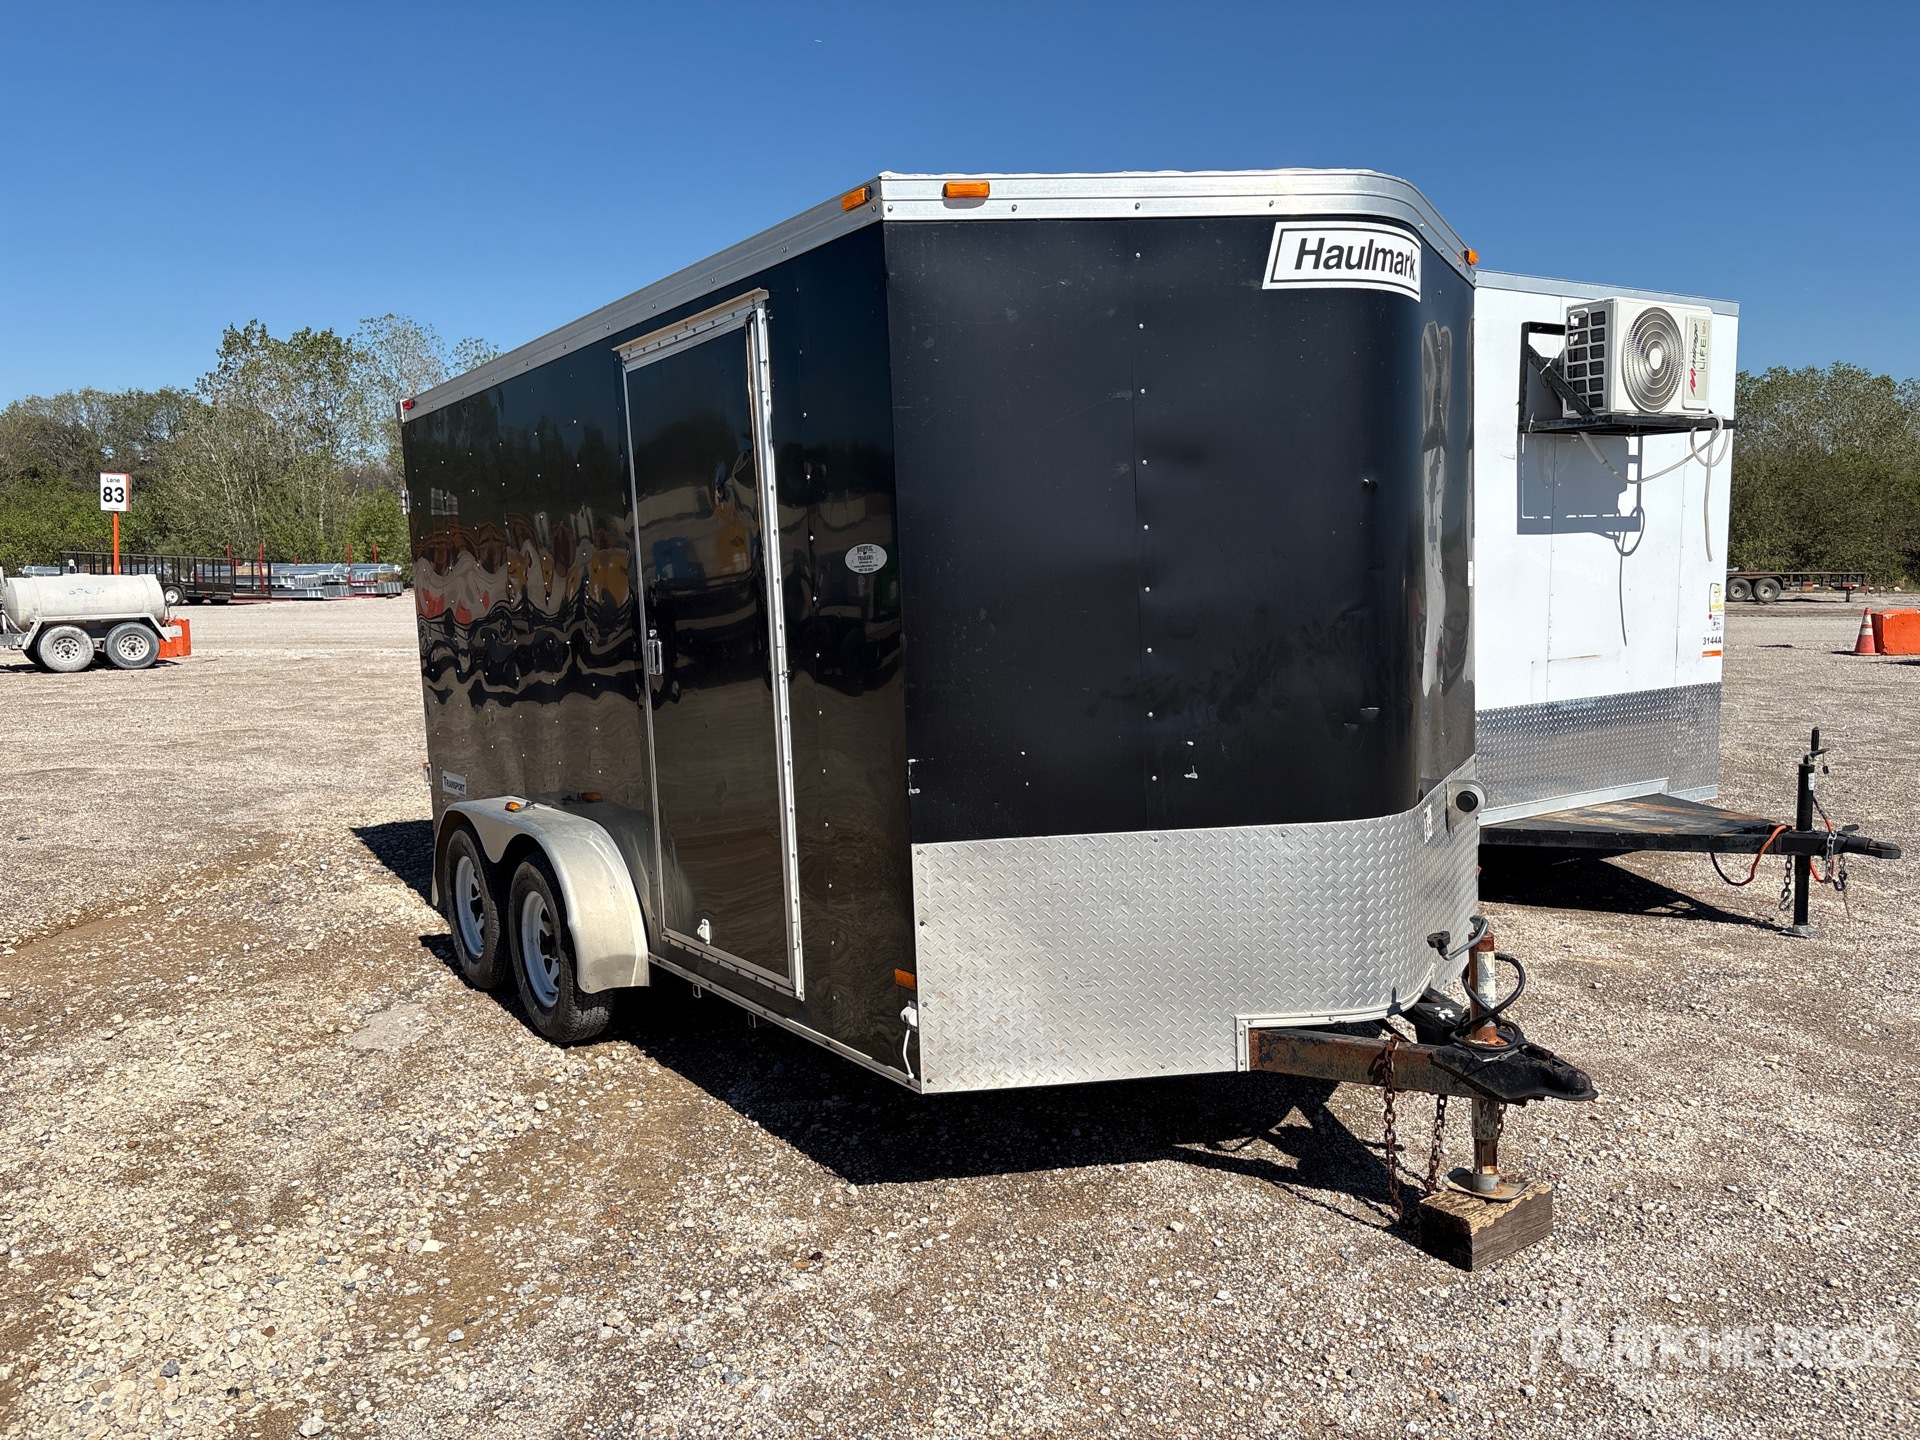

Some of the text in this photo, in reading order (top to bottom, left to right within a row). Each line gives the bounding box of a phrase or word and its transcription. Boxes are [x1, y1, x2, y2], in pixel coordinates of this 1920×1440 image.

[1294, 237, 1416, 281] Haulmark
[103, 486, 125, 503] 83
[1702, 636, 1722, 646] 3144A
